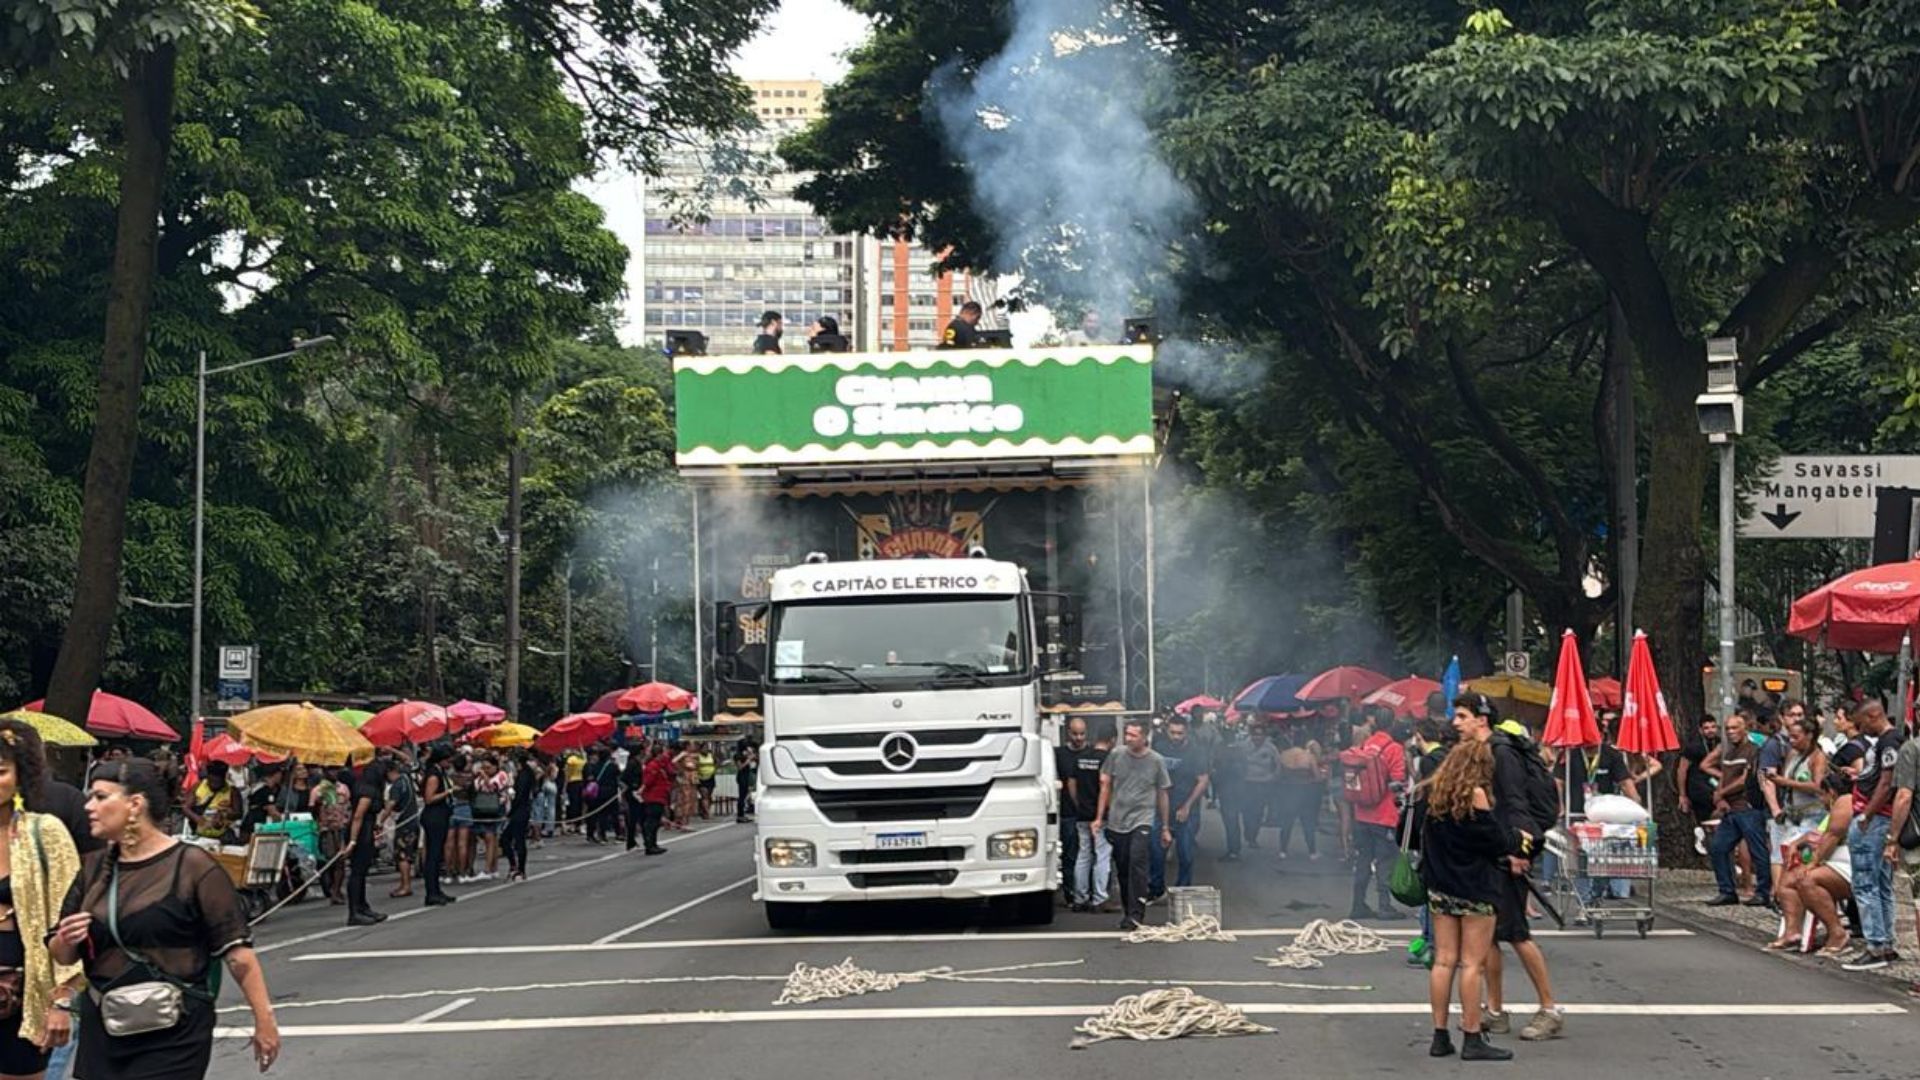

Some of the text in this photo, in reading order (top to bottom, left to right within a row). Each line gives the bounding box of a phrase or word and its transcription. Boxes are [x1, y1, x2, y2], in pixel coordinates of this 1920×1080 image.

[1794, 462, 1882, 478] Savassi
[1765, 483, 1908, 502] Mangabei
[812, 574, 978, 593] CAPITÃO ELÉTRICO
